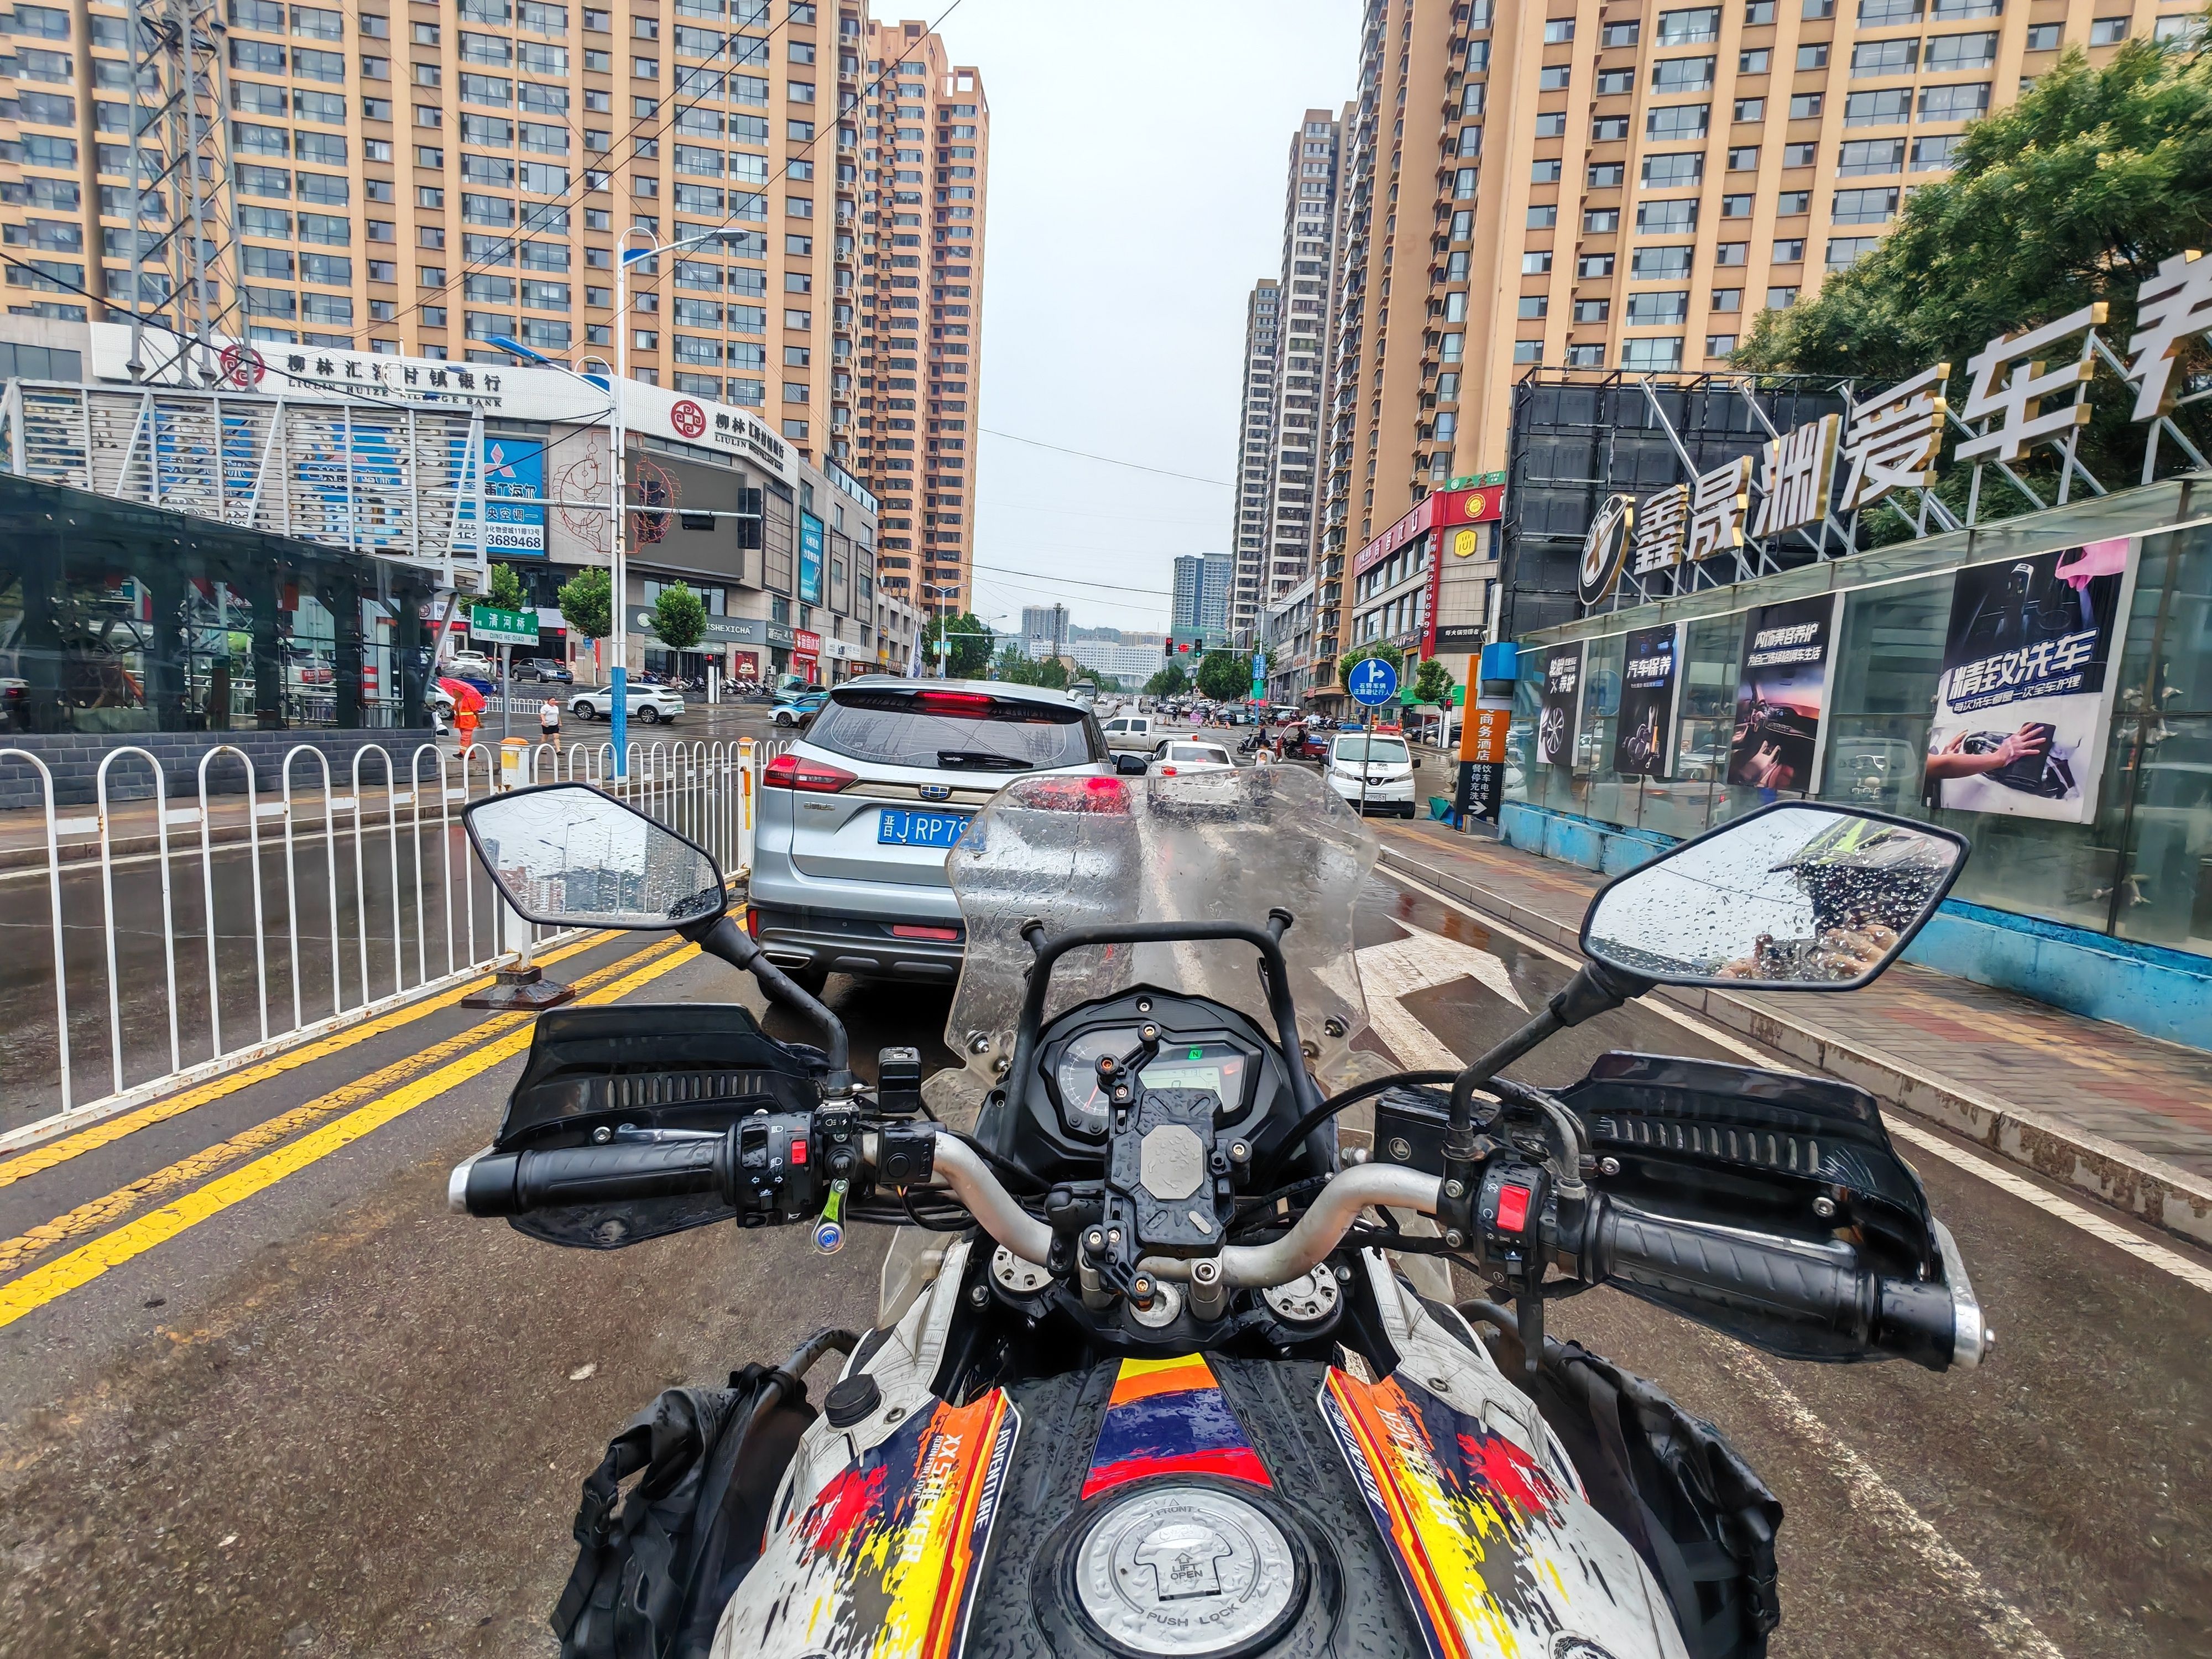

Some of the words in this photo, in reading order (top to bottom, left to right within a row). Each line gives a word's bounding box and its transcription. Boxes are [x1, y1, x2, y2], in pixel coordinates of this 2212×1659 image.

[347, 385, 388, 397] HUIZE
[467, 397, 502, 408] BANK
[715, 435, 747, 448] LIULIN
[489, 613, 525, 632] 清河桥
[1754, 623, 1819, 649] 内饰美容养护
[1627, 656, 1672, 679] 汽车保养
[1948, 630, 2097, 701] 精致洗车
[1559, 674, 1576, 693] 养护
[1954, 674, 2083, 712] 每次洗车都是一次全车护理
[1476, 713, 1495, 761] 商务酒店
[1472, 764, 1492, 773] 餐饮
[1472, 773, 1491, 782] 停车
[1469, 791, 1489, 800] 洗车
[1470, 782, 1490, 791] 充电
[883, 815, 969, 843] 晋J·RP7
[928, 1435, 945, 1458] BORN
[938, 1433, 963, 1459] XX
[922, 1457, 934, 1477] FOR
[1328, 1405, 1389, 1515] ADVENTURE
[912, 1474, 927, 1500] LOVE
[973, 1428, 1011, 1532] ADVENTURE
[1156, 1506, 1194, 1516] FRONT
[1170, 1570, 1203, 1580] OPEN
[1172, 1563, 1197, 1572] LIFT
[1146, 1611, 1188, 1627] PUSH
[1199, 1603, 1239, 1625] LOCK
